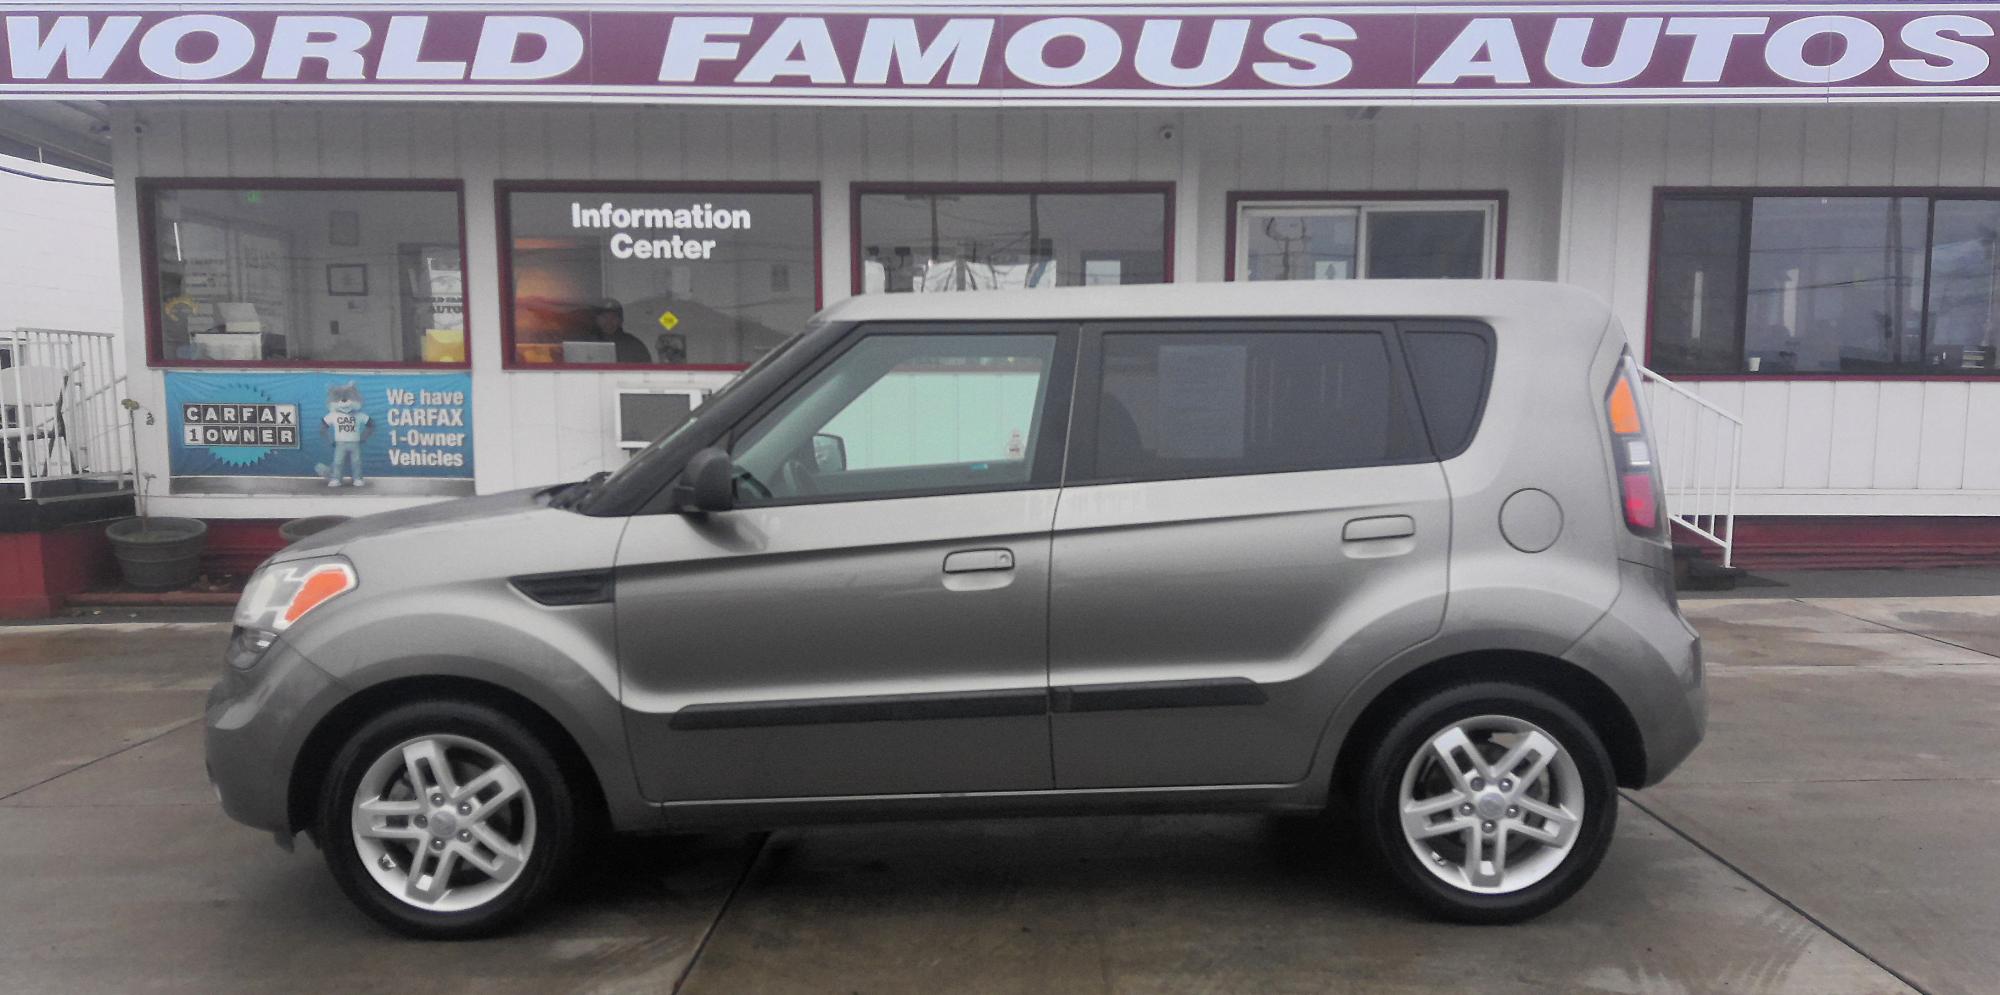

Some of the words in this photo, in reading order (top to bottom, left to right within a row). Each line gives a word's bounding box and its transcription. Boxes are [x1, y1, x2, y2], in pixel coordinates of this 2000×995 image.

[6, 15, 584, 80] WORLD
[658, 17, 1358, 87] FAMOUS
[1417, 15, 1995, 84] AUTOS
[572, 203, 751, 229] Information
[610, 233, 716, 259] Center
[387, 389, 415, 405] We
[420, 388, 464, 405] have
[186, 406, 296, 424] CARFAX
[337, 416, 355, 424] CAR
[387, 408, 464, 426] CARFAX
[339, 424, 355, 432] FOX
[389, 430, 465, 446] 1-Owner
[389, 449, 464, 466] Vehicles
